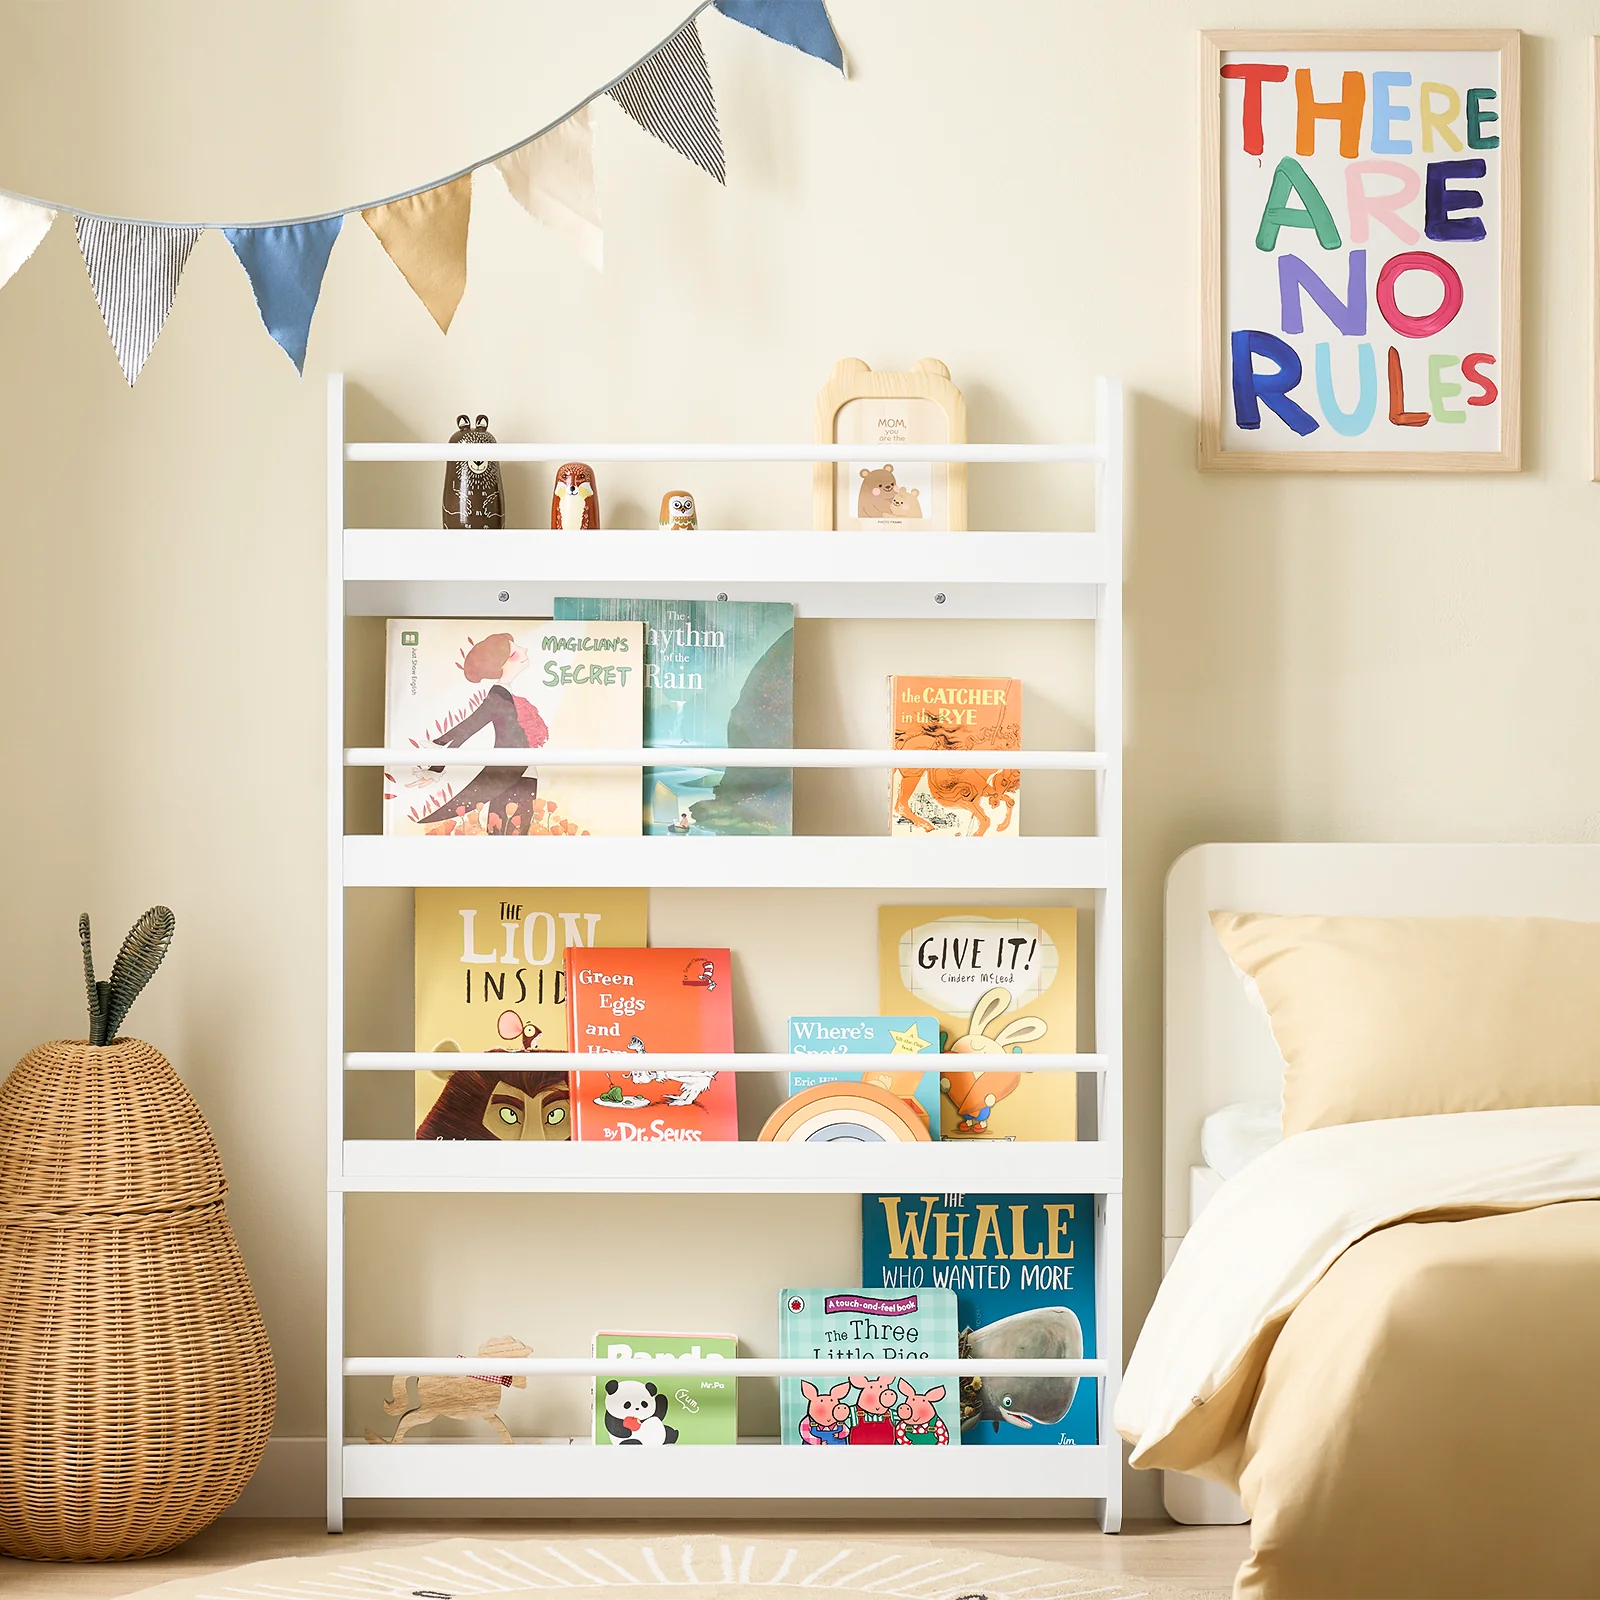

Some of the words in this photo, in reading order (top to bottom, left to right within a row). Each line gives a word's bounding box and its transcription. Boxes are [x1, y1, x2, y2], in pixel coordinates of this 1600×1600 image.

[1220, 64, 1500, 158] THERE
[1255, 156, 1487, 252] ARE
[1278, 249, 1464, 338] NO
[1231, 330, 1499, 437] RULES
[878, 418, 906, 428] MOM,
[667, 610, 686, 620] The
[541, 635, 630, 654] MAGICIAN'S
[644, 621, 726, 653] hythm
[664, 652, 675, 662] of
[675, 652, 690, 662] the
[542, 660, 632, 687] SECRET
[644, 663, 703, 690] Rain
[901, 687, 921, 703] the
[922, 687, 1007, 706] CATCHER
[901, 712, 913, 723] in
[938, 707, 978, 725] RYE
[500, 901, 523, 920] THE
[918, 937, 985, 969] GIVE
[997, 937, 1037, 971] IT!
[466, 968, 568, 1004] INSID
[579, 969, 634, 986] Green
[941, 973, 975, 983] Cinders
[599, 993, 646, 1016] Eggs
[585, 1022, 620, 1036] and
[793, 1021, 874, 1040] Where's
[794, 1076, 817, 1087] Eric
[603, 1128, 618, 1140] By
[617, 1122, 648, 1141] Dr.
[649, 1119, 702, 1141] Seuss
[878, 1196, 1075, 1260] WHALE
[882, 1265, 924, 1288] WHO
[933, 1264, 1011, 1290] WANTED
[1020, 1264, 1075, 1290] MORE
[829, 1300, 835, 1308] A
[897, 1301, 916, 1312] book
[825, 1330, 848, 1342] The
[850, 1318, 919, 1343] Three
[1058, 1432, 1076, 1446] Jim
